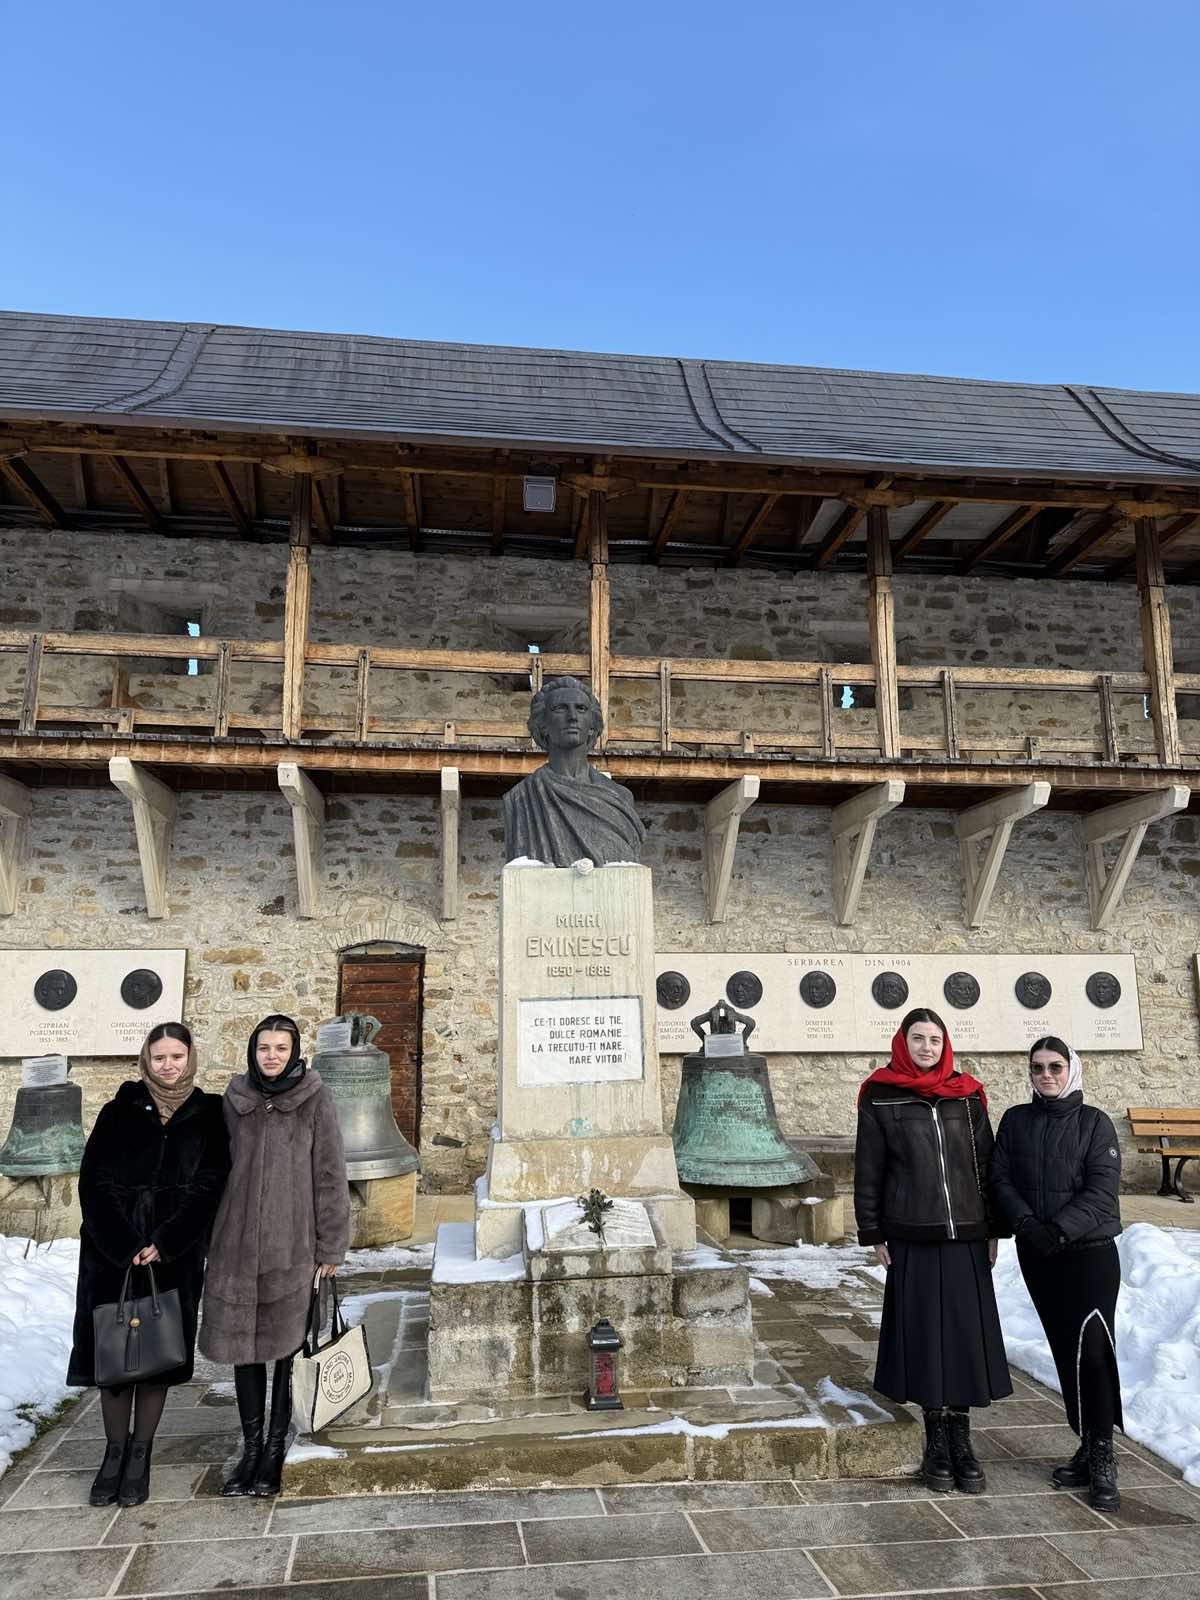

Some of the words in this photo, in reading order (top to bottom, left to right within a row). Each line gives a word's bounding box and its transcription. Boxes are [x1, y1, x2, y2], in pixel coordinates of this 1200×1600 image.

[556, 913, 600, 928] MIHAI
[526, 935, 631, 957] EMINESCU
[864, 959, 885, 967] DIN
[891, 959, 911, 967] 1904
[559, 1016, 591, 1026] DORESC
[594, 1015, 605, 1025] EU
[549, 1029, 576, 1039] DULCE
[531, 1043, 544, 1053] LA
[568, 1055, 592, 1065] MARE
